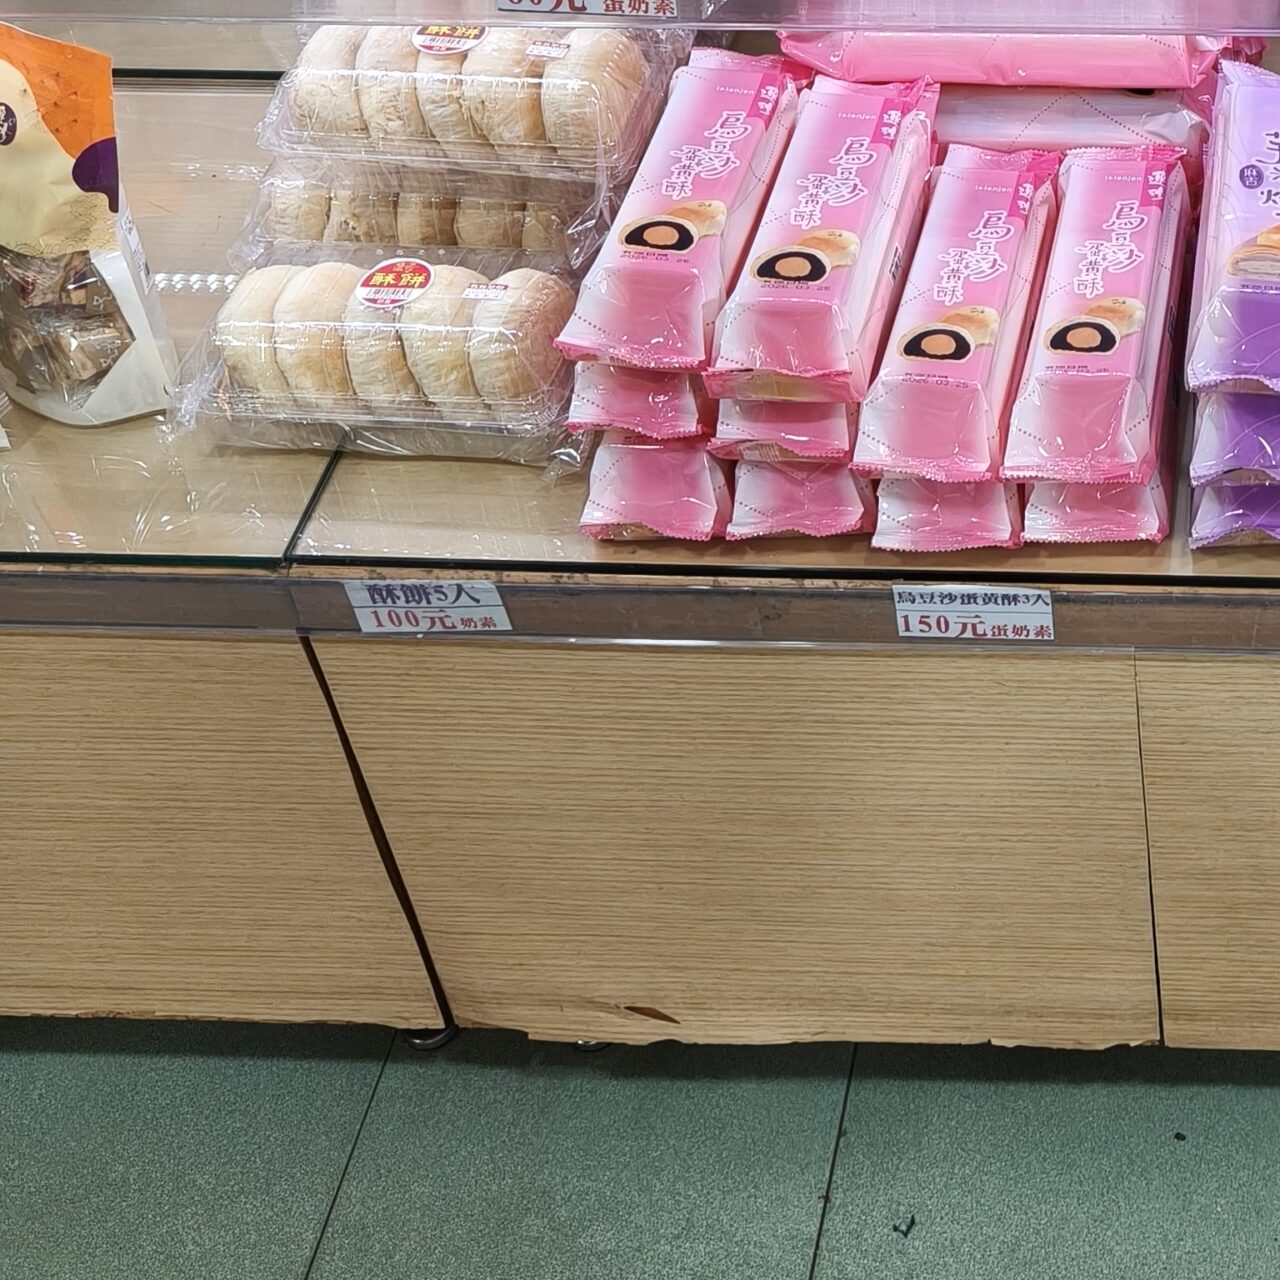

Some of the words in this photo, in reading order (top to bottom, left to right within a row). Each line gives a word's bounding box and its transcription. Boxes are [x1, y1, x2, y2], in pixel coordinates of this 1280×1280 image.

[364, 583, 482, 605] 酥餅5入
[896, 591, 1051, 607] 烏豆沙蛋黃酥3入
[370, 609, 458, 631] 100元
[900, 614, 989, 638] 150元
[990, 624, 1053, 639] 蛋奶素
